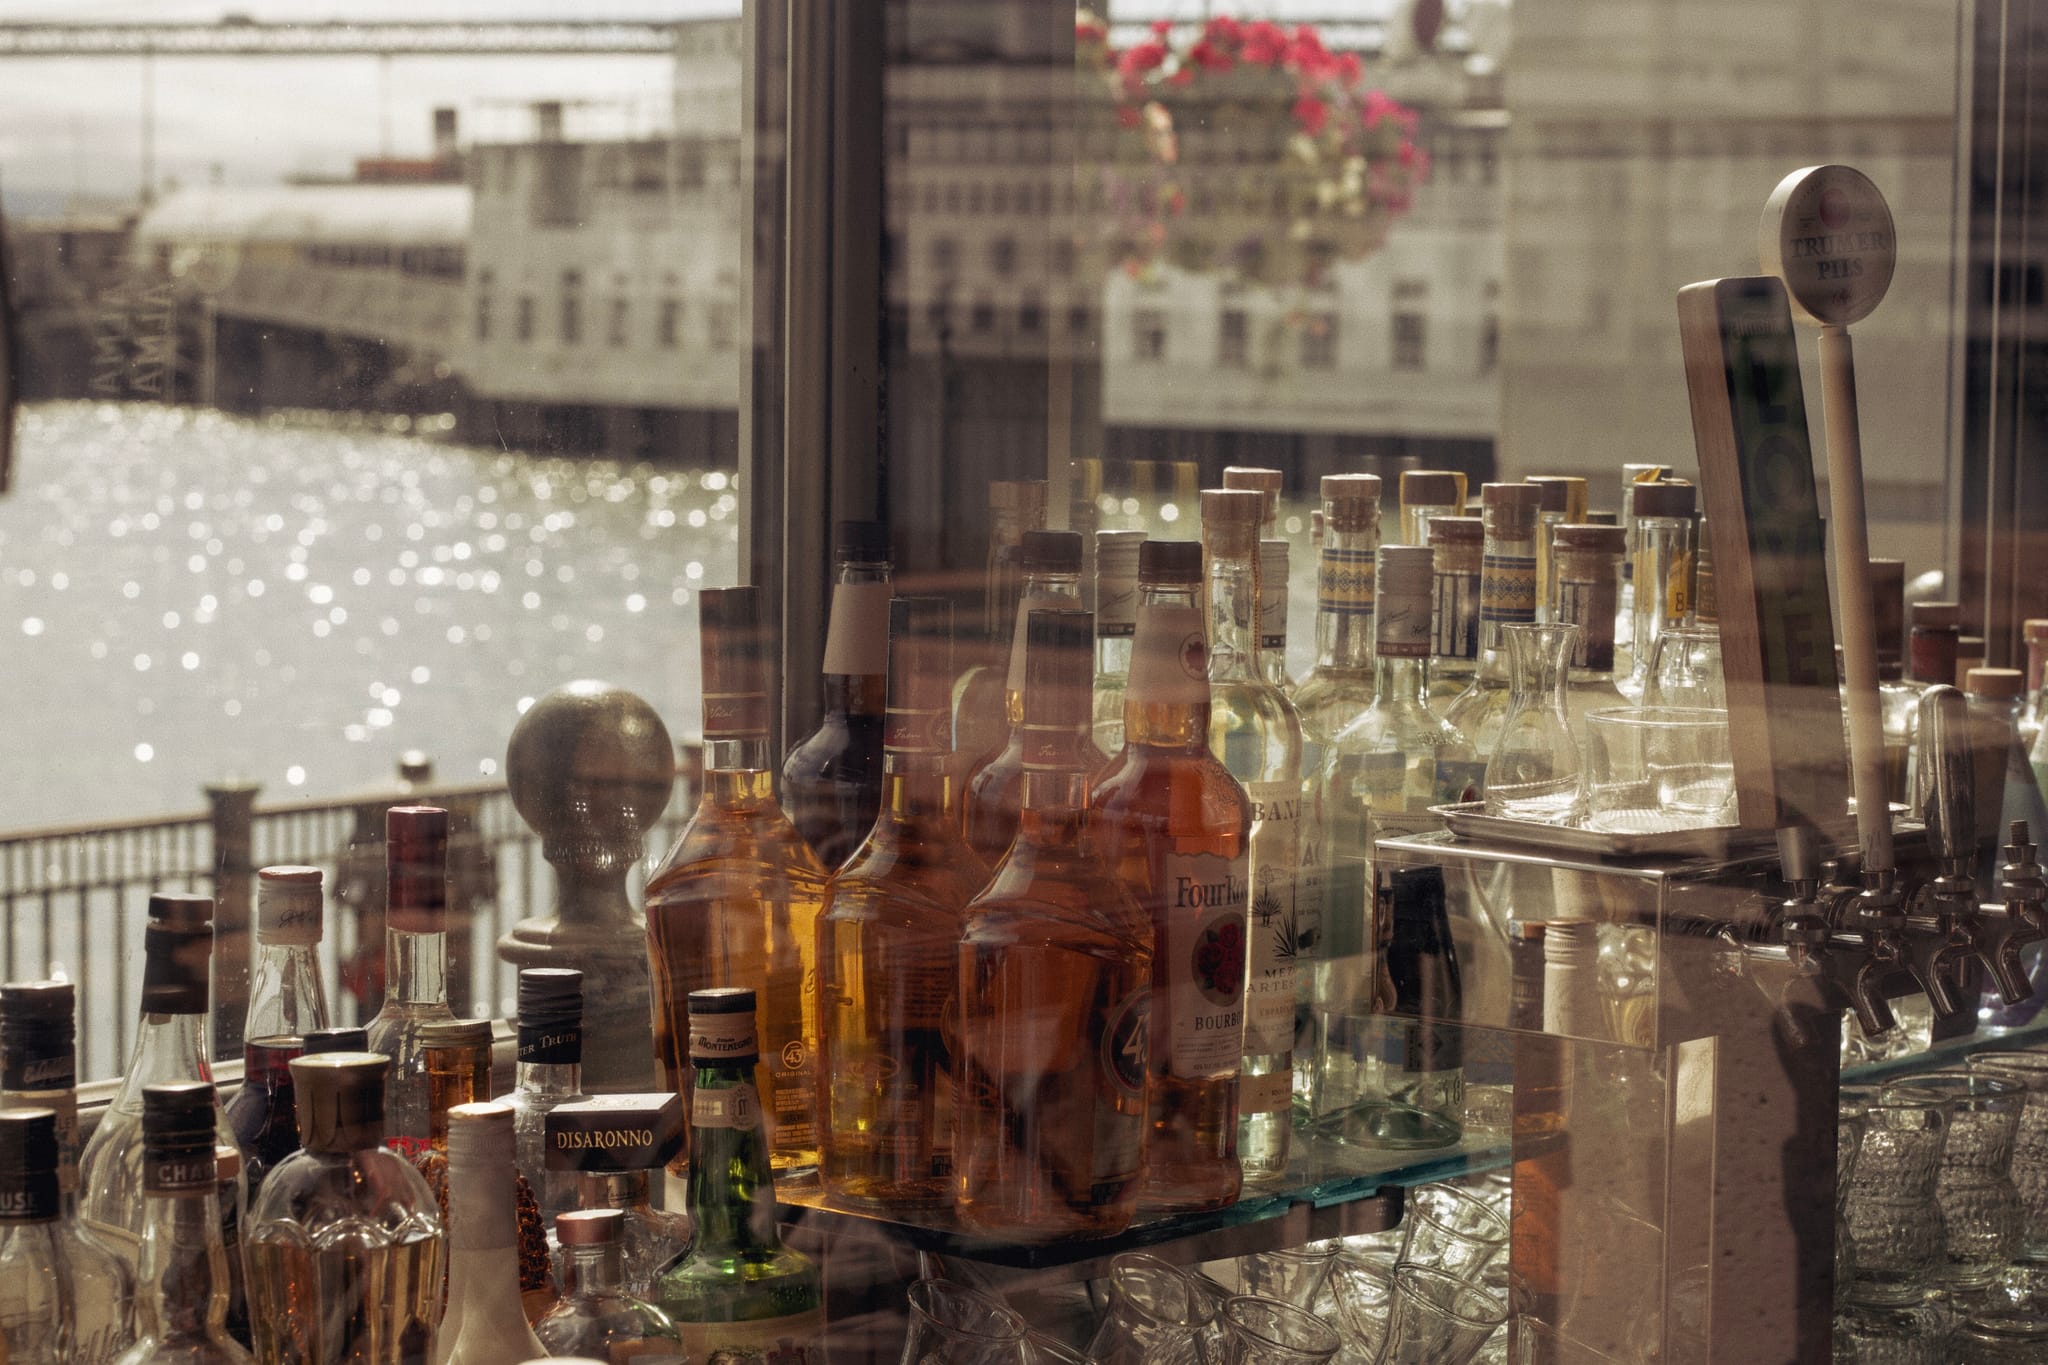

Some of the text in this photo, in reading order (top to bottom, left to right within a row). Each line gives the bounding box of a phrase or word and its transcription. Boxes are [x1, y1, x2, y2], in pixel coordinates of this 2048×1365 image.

[1175, 876, 1225, 908] Four
[785, 1049, 803, 1063] 43
[557, 1129, 653, 1149] DISARONNO
